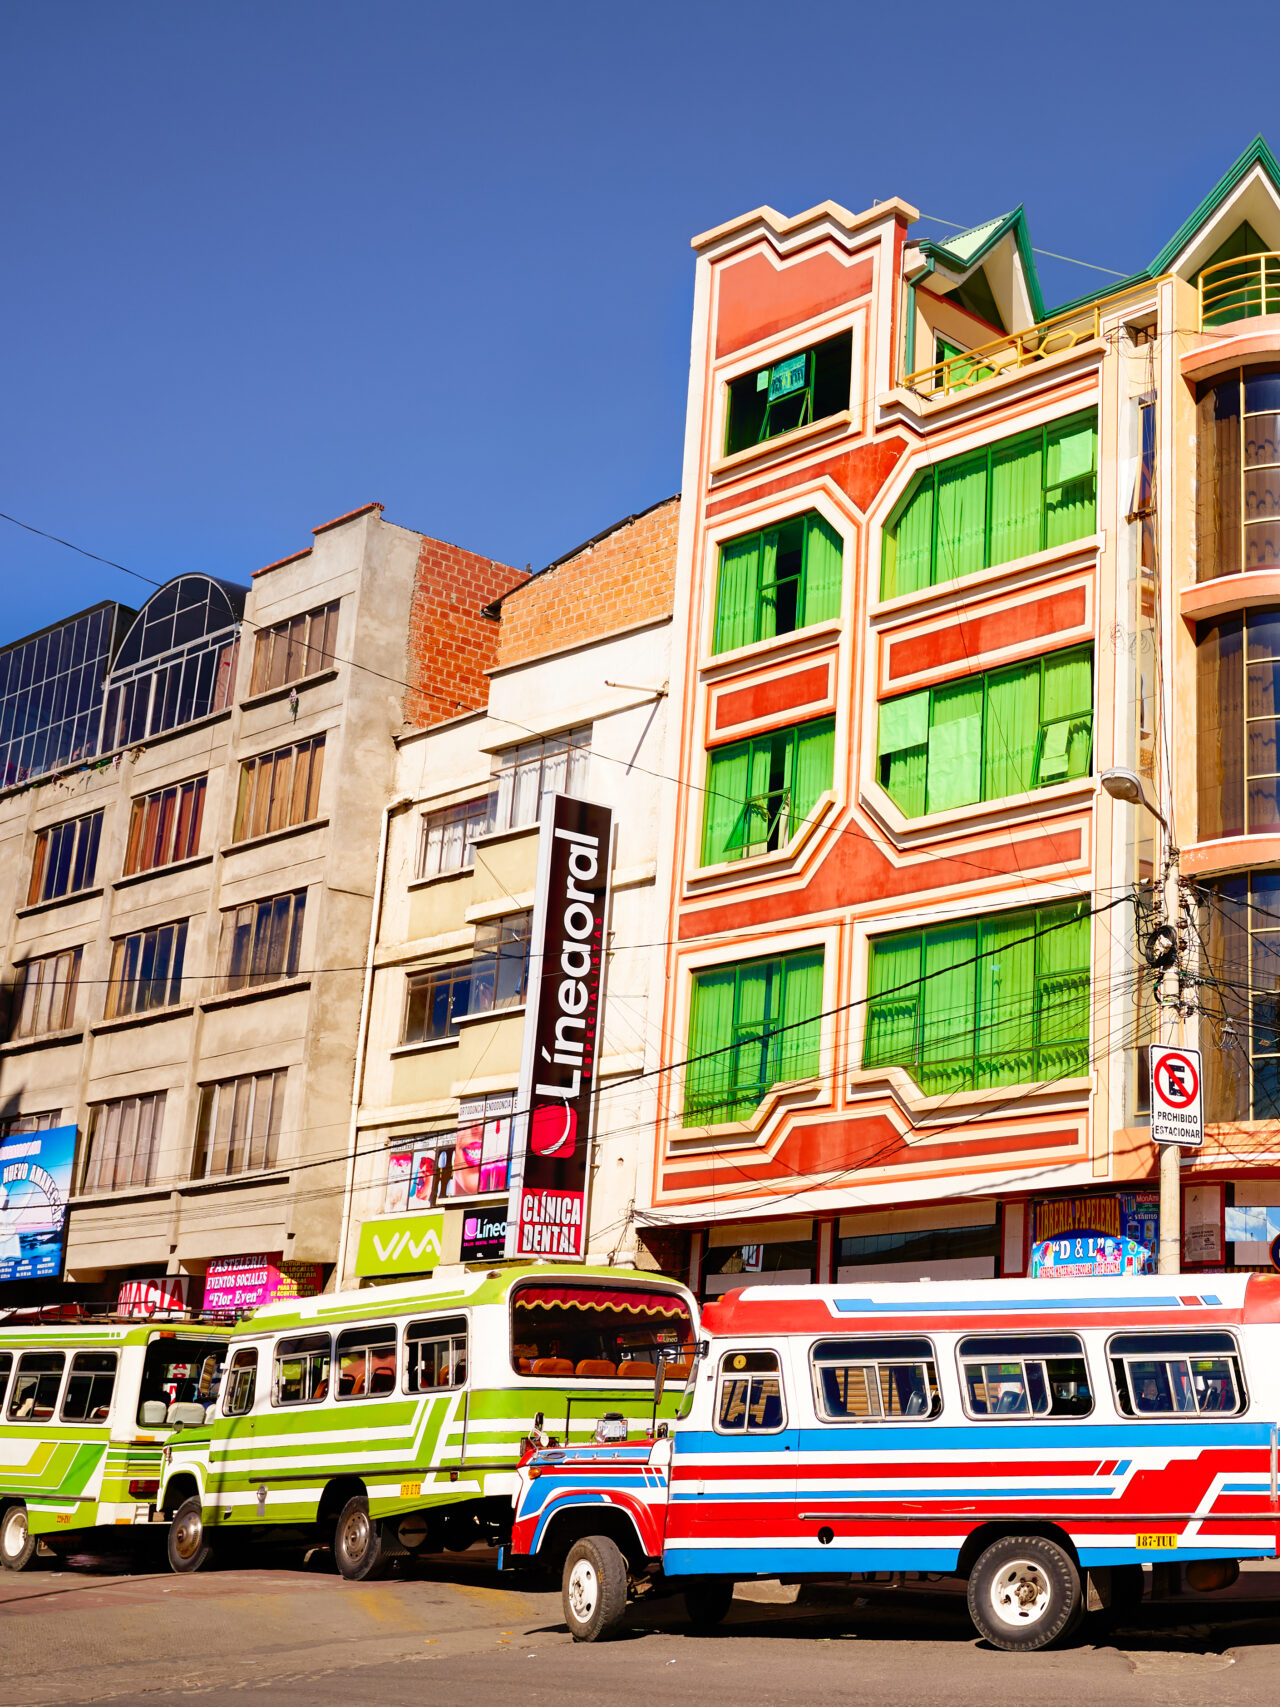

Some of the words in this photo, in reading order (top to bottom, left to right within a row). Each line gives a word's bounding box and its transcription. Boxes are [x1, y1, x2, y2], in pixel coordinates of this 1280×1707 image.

[584, 917, 603, 1078] ESPECIALISTAS
[1155, 1125, 1200, 1139] ESTACIONAR
[3, 1162, 29, 1185] NUEVO
[522, 1191, 582, 1226] CLÍNICA
[1036, 1200, 1073, 1245] LIBRERIA
[1075, 1197, 1120, 1238] PAPELERIA
[373, 1229, 441, 1262] VIVA
[521, 1221, 577, 1254] DENTAL
[1074, 1238, 1084, 1258] &
[209, 1255, 268, 1274] PASTELERIA
[206, 1274, 235, 1290] EVENTOS
[236, 1271, 268, 1287] SOCIALES
